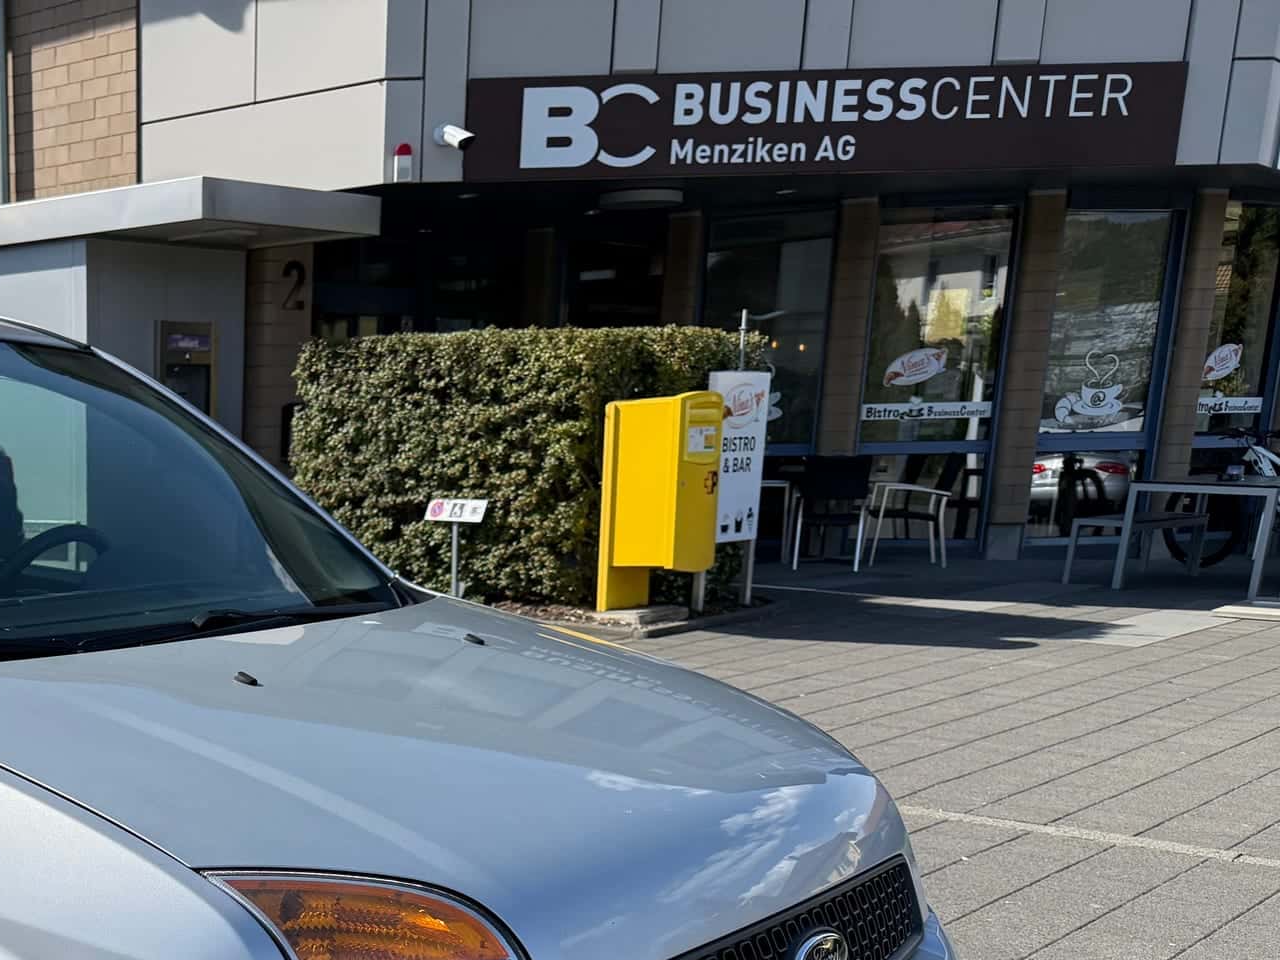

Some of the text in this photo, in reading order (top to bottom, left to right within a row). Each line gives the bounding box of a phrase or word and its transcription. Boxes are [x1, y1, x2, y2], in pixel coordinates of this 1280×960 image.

[672, 73, 1134, 127] BUSINESSCENTER
[519, 83, 660, 169] BC
[669, 135, 856, 166] Menziken AG
[282, 260, 306, 311] 2
[865, 407, 900, 418] Bistro
[722, 436, 756, 452] BISTRO
[722, 457, 752, 473] & BAR
